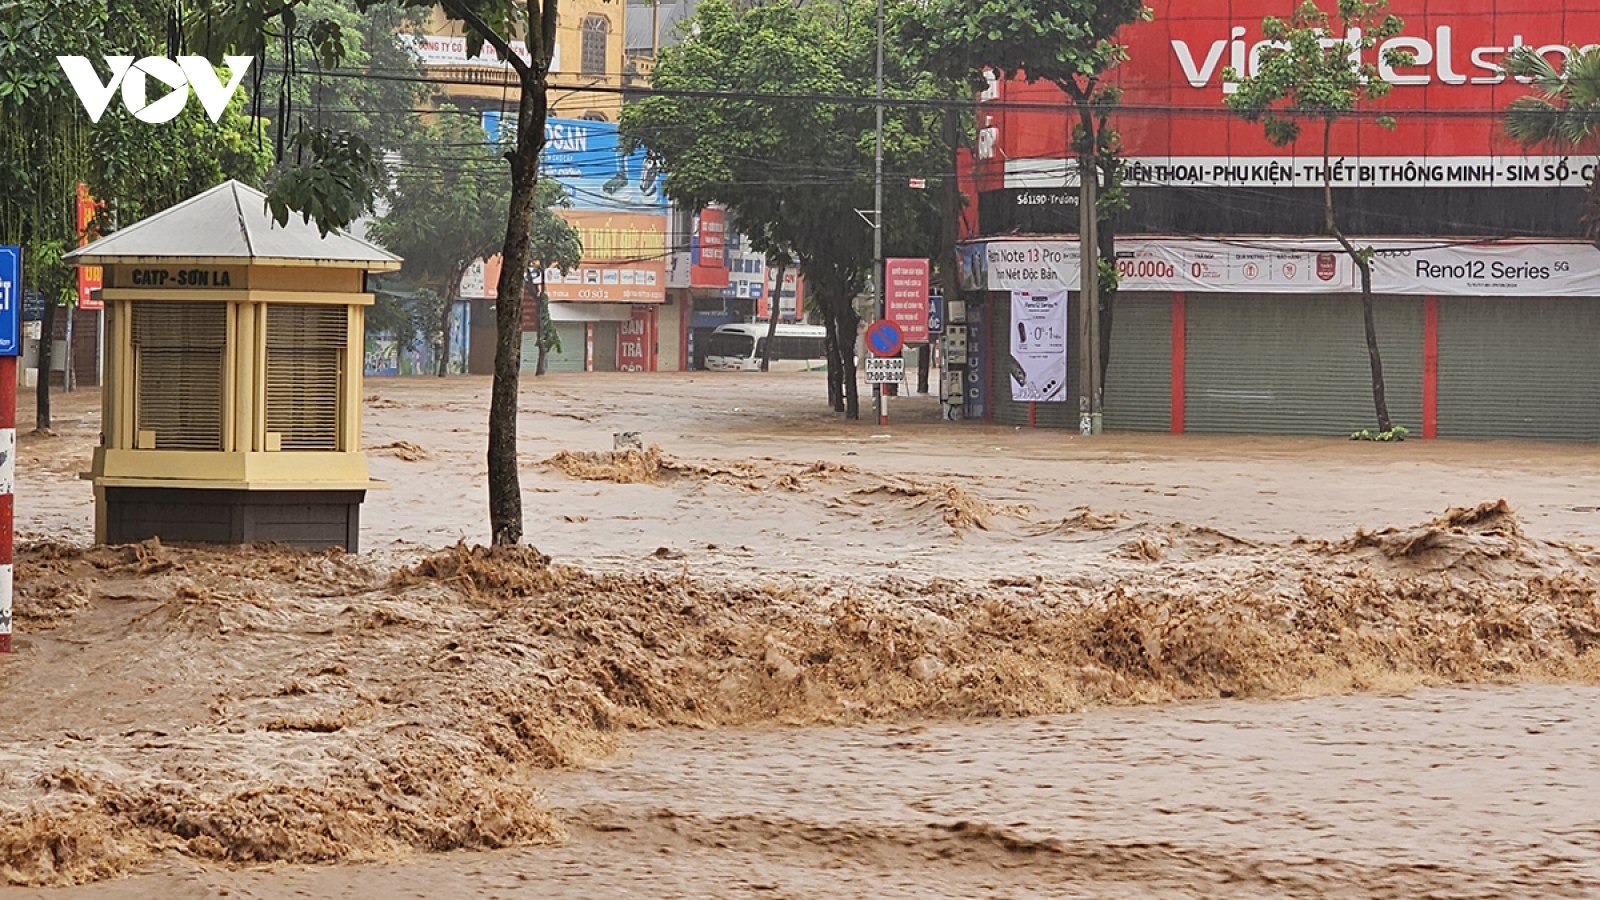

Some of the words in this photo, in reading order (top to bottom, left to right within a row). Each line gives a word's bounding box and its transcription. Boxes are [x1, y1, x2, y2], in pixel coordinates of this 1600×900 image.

[1155, 164, 1203, 185] THOẠI
[1213, 164, 1249, 185] PHỤ
[1252, 160, 1292, 185] KIỆN
[1359, 165, 1376, 185] BỊ
[1379, 160, 1444, 181] THÔNG
[1448, 165, 1494, 181] MINH
[1507, 164, 1540, 181] SIM
[1544, 156, 1569, 181] SỐ
[1581, 164, 1600, 181] C
[1001, 249, 1025, 262] Note
[1028, 249, 1039, 262] 13
[1043, 249, 1061, 262] Pro
[212, 270, 231, 286] LA
[1115, 260, 1174, 278] 90.000đ
[1416, 260, 1485, 279] Reno12
[1492, 260, 1550, 279] Series
[1554, 262, 1569, 271] 5G
